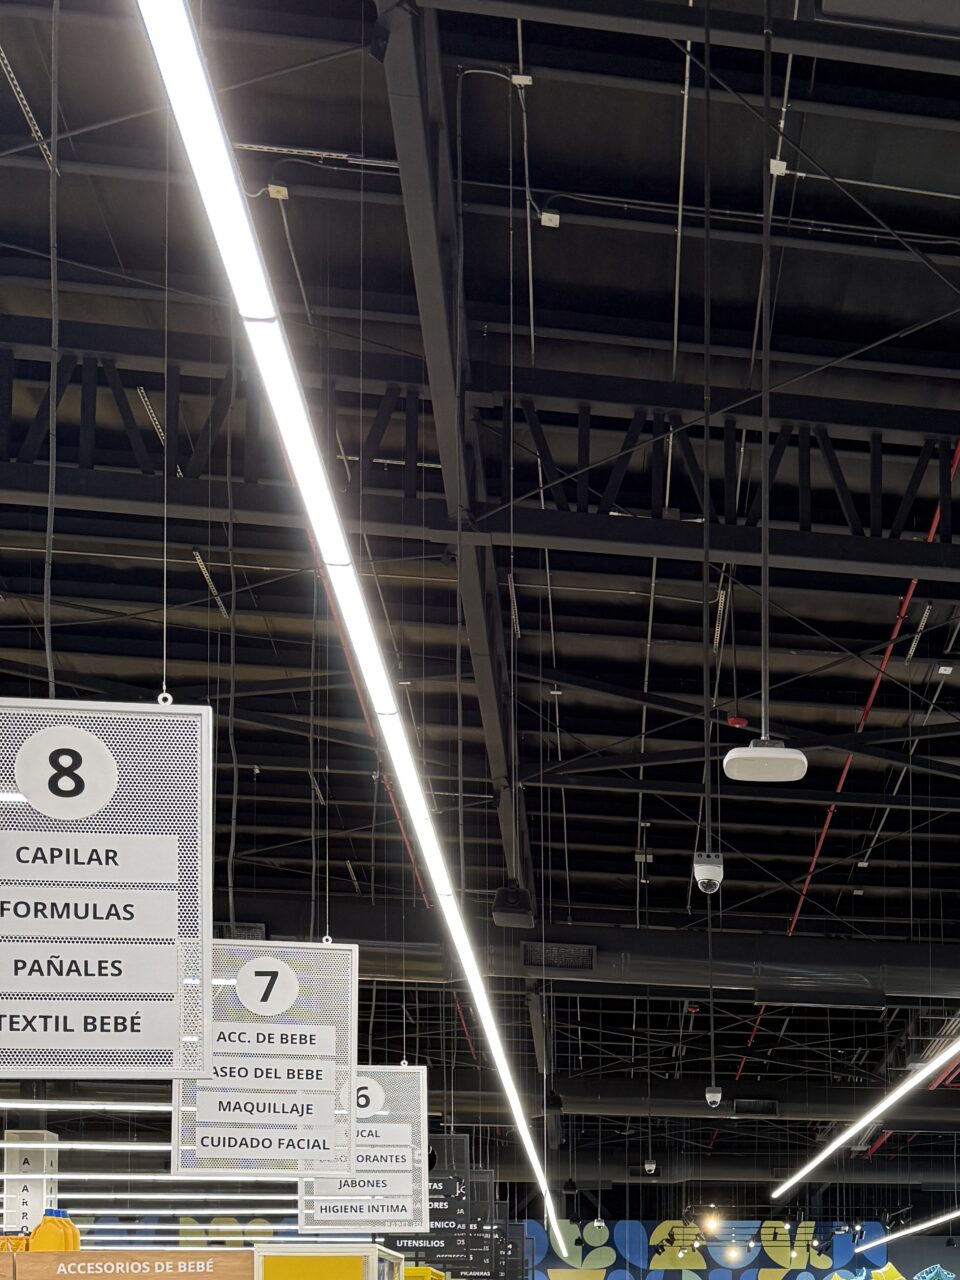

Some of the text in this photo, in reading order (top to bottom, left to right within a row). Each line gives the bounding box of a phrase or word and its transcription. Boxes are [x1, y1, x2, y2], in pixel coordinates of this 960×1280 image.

[47, 747, 86, 798] 8
[15, 845, 120, 867] CAPILAR
[0, 900, 135, 921] FORMULAS
[13, 955, 123, 977] PAÑALES
[253, 970, 279, 1003] 7
[0, 1011, 142, 1034] TEXTIL BEBÉ
[216, 1031, 317, 1046] ACC. DE BEBE
[212, 1066, 324, 1082] ASEO DEL BEBE
[356, 1086, 371, 1109] 6
[217, 1100, 314, 1117] MAQUILLAJE
[355, 1129, 381, 1138] UCAL
[200, 1135, 331, 1151] CUIDADO FACIAL
[338, 1179, 388, 1190] JABONES
[319, 1204, 408, 1214] HIGIENE INTIMA
[396, 1239, 445, 1248] UTENSILIOS
[56, 1257, 214, 1275] ACCESORIOS DE BEBÉ
